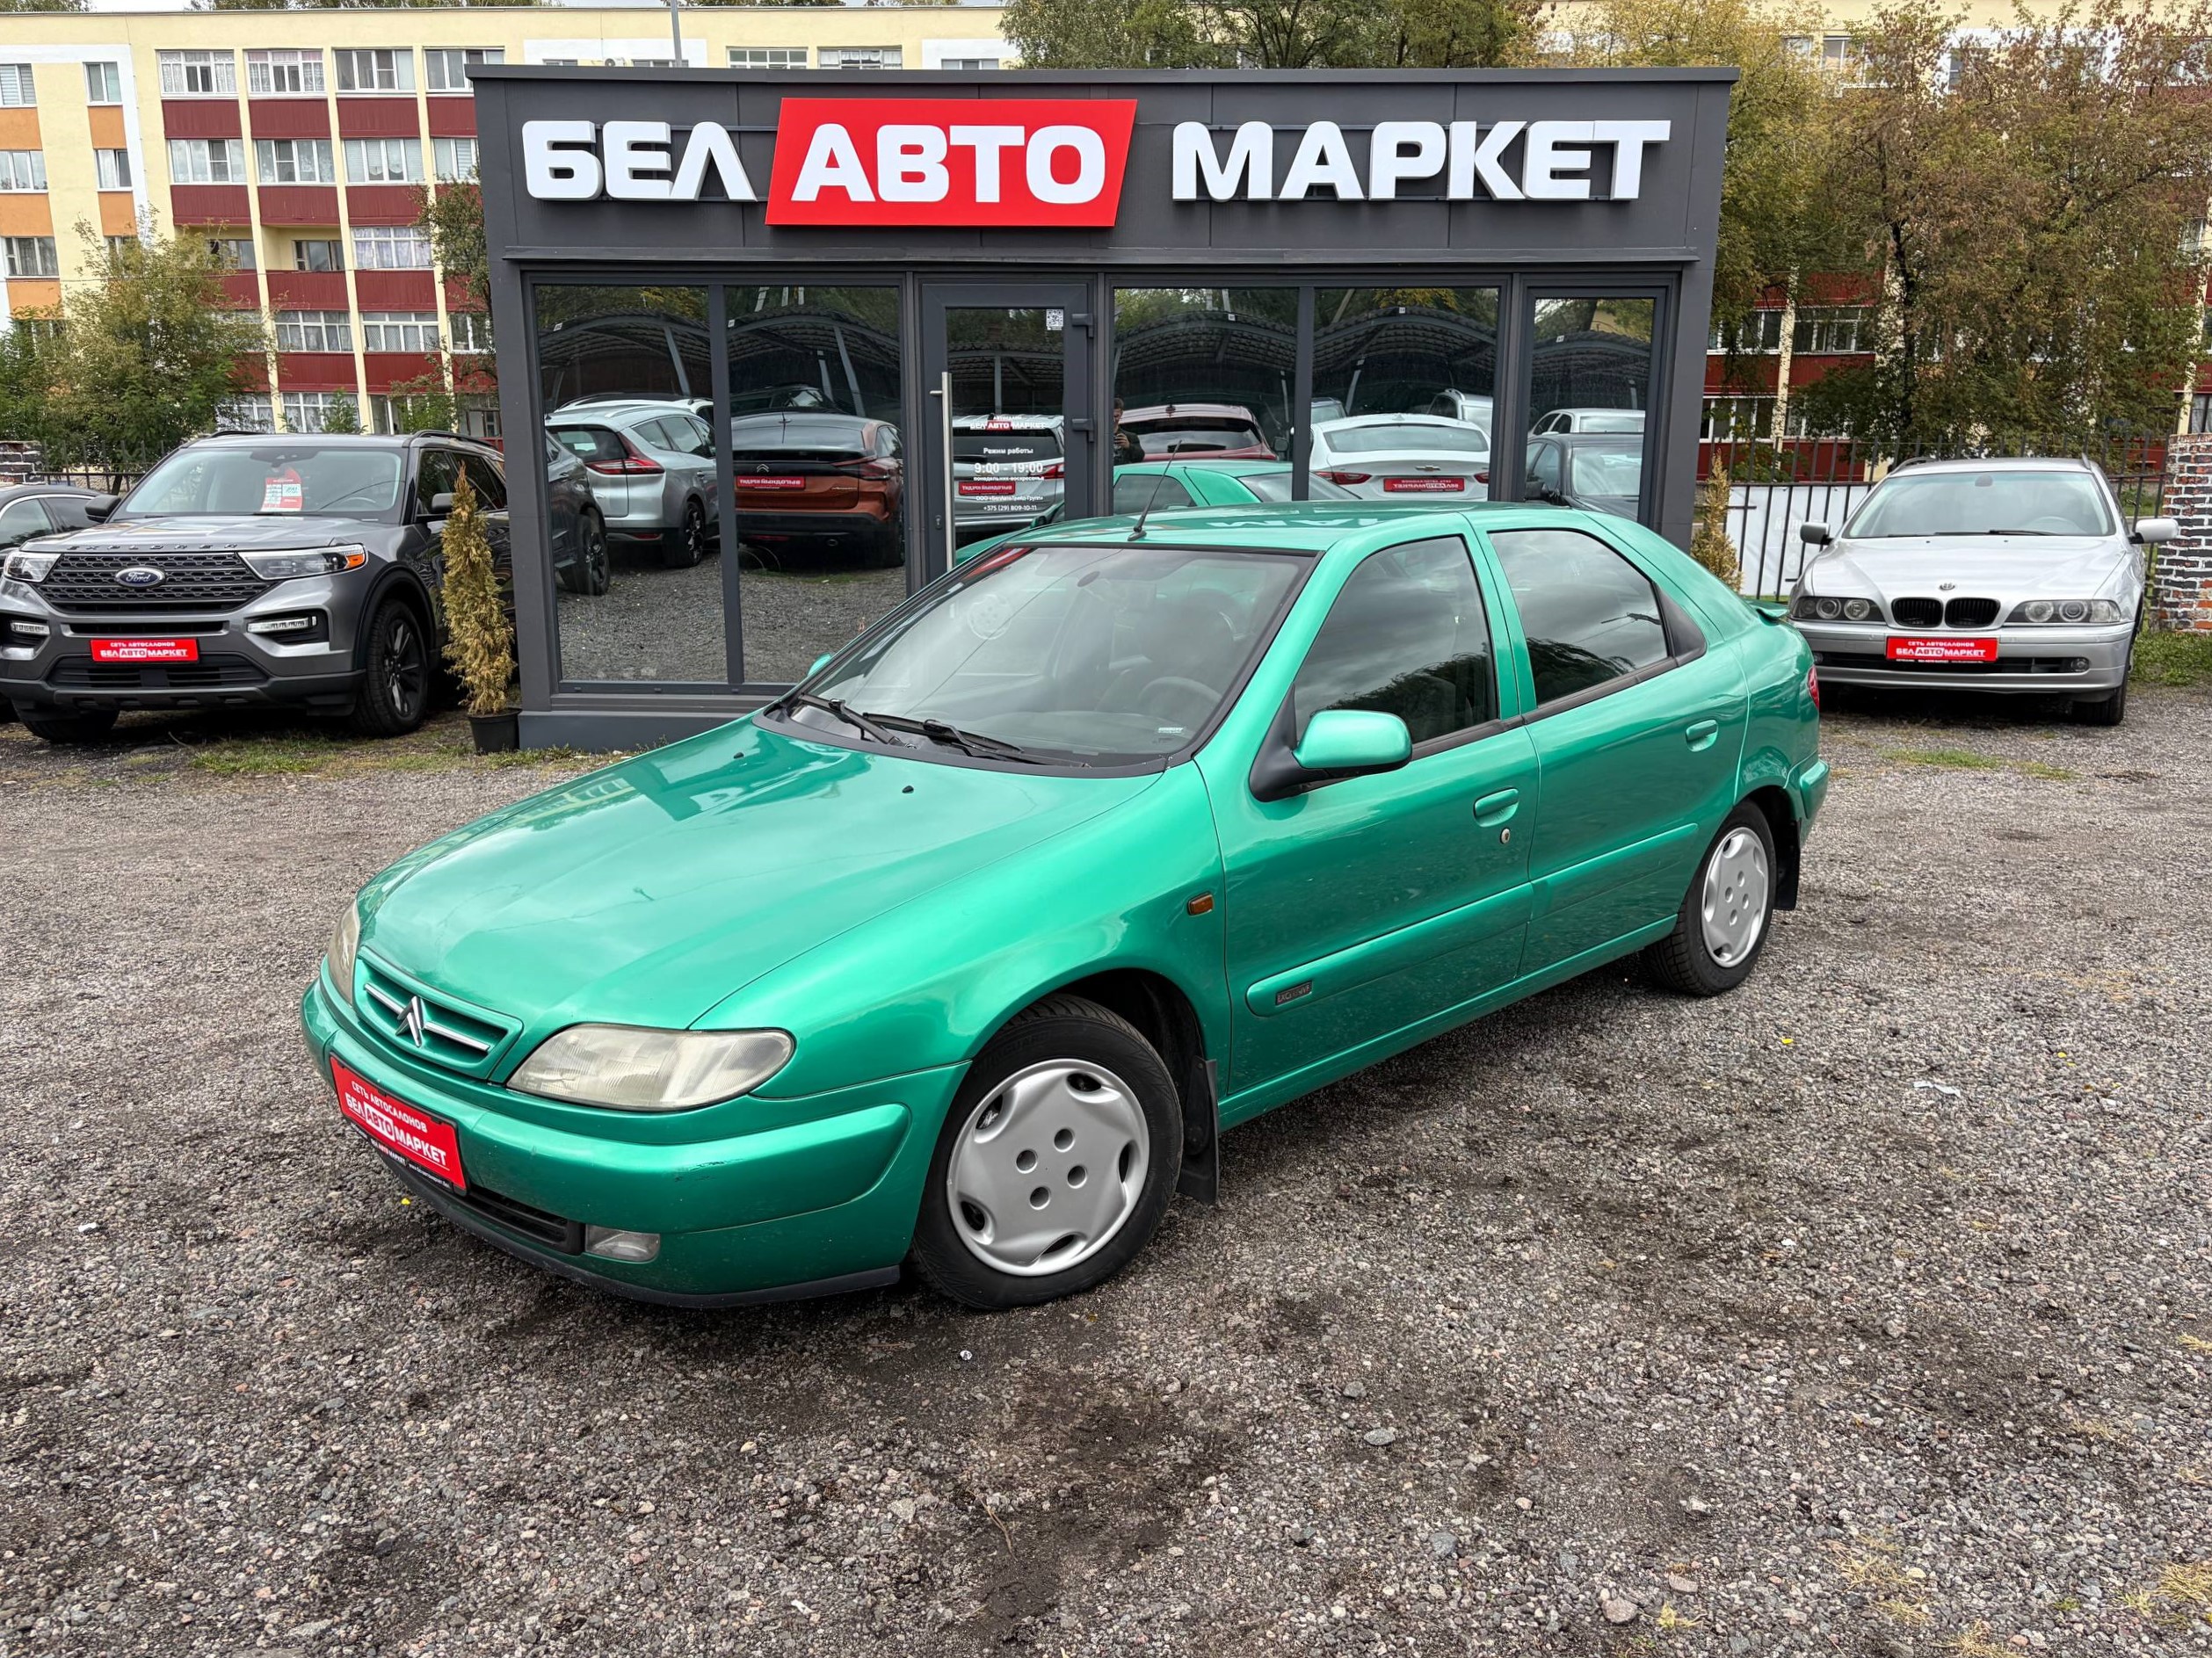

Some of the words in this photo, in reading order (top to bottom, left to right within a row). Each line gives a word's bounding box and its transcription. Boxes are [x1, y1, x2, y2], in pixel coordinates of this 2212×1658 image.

[521, 120, 758, 202] БЕЛ
[791, 123, 1106, 204] АВТО
[1171, 119, 1672, 201] МАРКЕТ
[1012, 422, 1046, 431] МАРКЕТ
[974, 462, 999, 473] 9:00
[1012, 462, 1043, 473] 19:00
[125, 571, 152, 583] Ford
[1944, 648, 1986, 657] МАРКЕТ
[352, 1081, 369, 1099] СЕТЬ
[370, 1093, 428, 1133] АВТОСАЛОНОВ
[344, 1092, 366, 1118] БЕЛ
[365, 1104, 395, 1139] АВТО
[395, 1126, 446, 1167] МАРКЕТ
